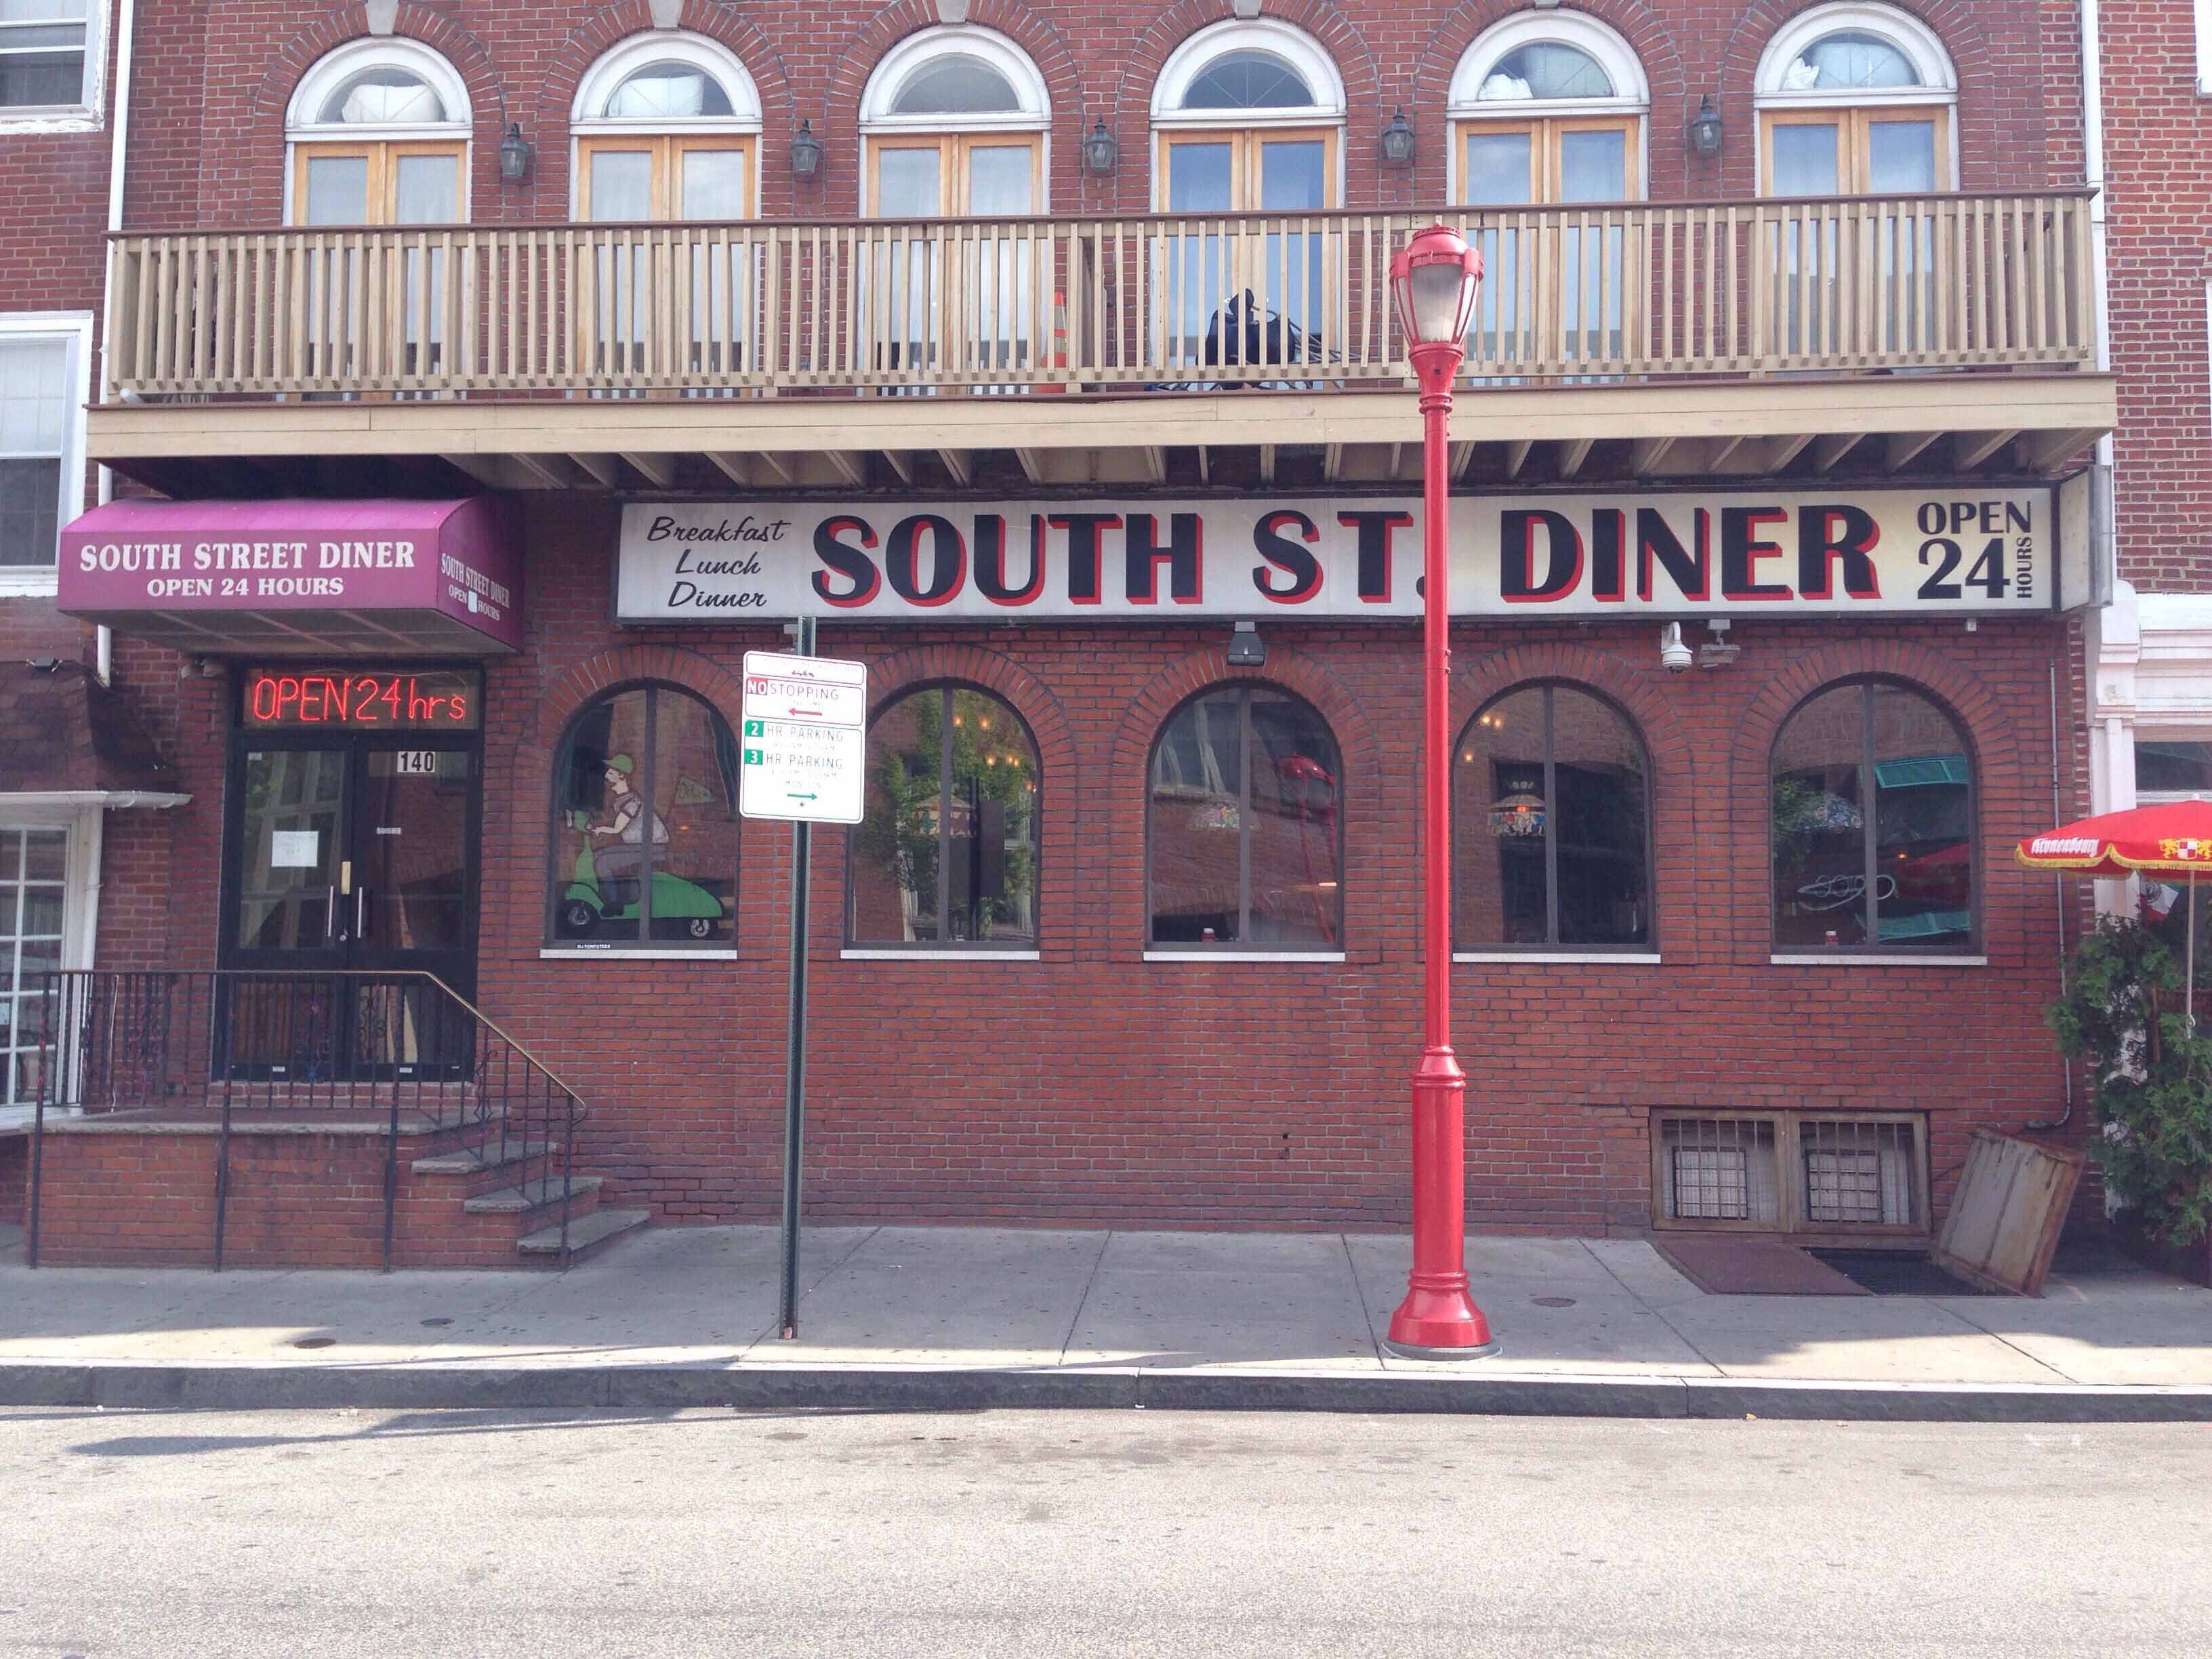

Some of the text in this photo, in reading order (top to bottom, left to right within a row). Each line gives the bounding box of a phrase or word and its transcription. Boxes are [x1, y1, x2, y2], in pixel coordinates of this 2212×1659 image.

[647, 516, 792, 542] Breakfast
[1917, 500, 2032, 535] OPEN
[79, 541, 415, 571] SOUTH STREET DINER
[674, 549, 762, 575] Lunch
[811, 514, 1204, 608] SOUTH
[1500, 505, 1883, 603] DINER
[1917, 537, 2011, 600] 24
[2016, 536, 2032, 598] HOURS
[146, 577, 344, 596] OPEN 24 HOURS
[441, 552, 510, 609] SOUTH STREET DINER
[668, 581, 768, 608] Dinner
[449, 584, 500, 621] OPEN HOURS
[253, 678, 350, 720] OPEN
[747, 680, 840, 701] NO STOPPING
[751, 722, 844, 743] 2 HR PARKING
[401, 752, 434, 773] 140
[750, 750, 842, 771] 3 HR PARKING
